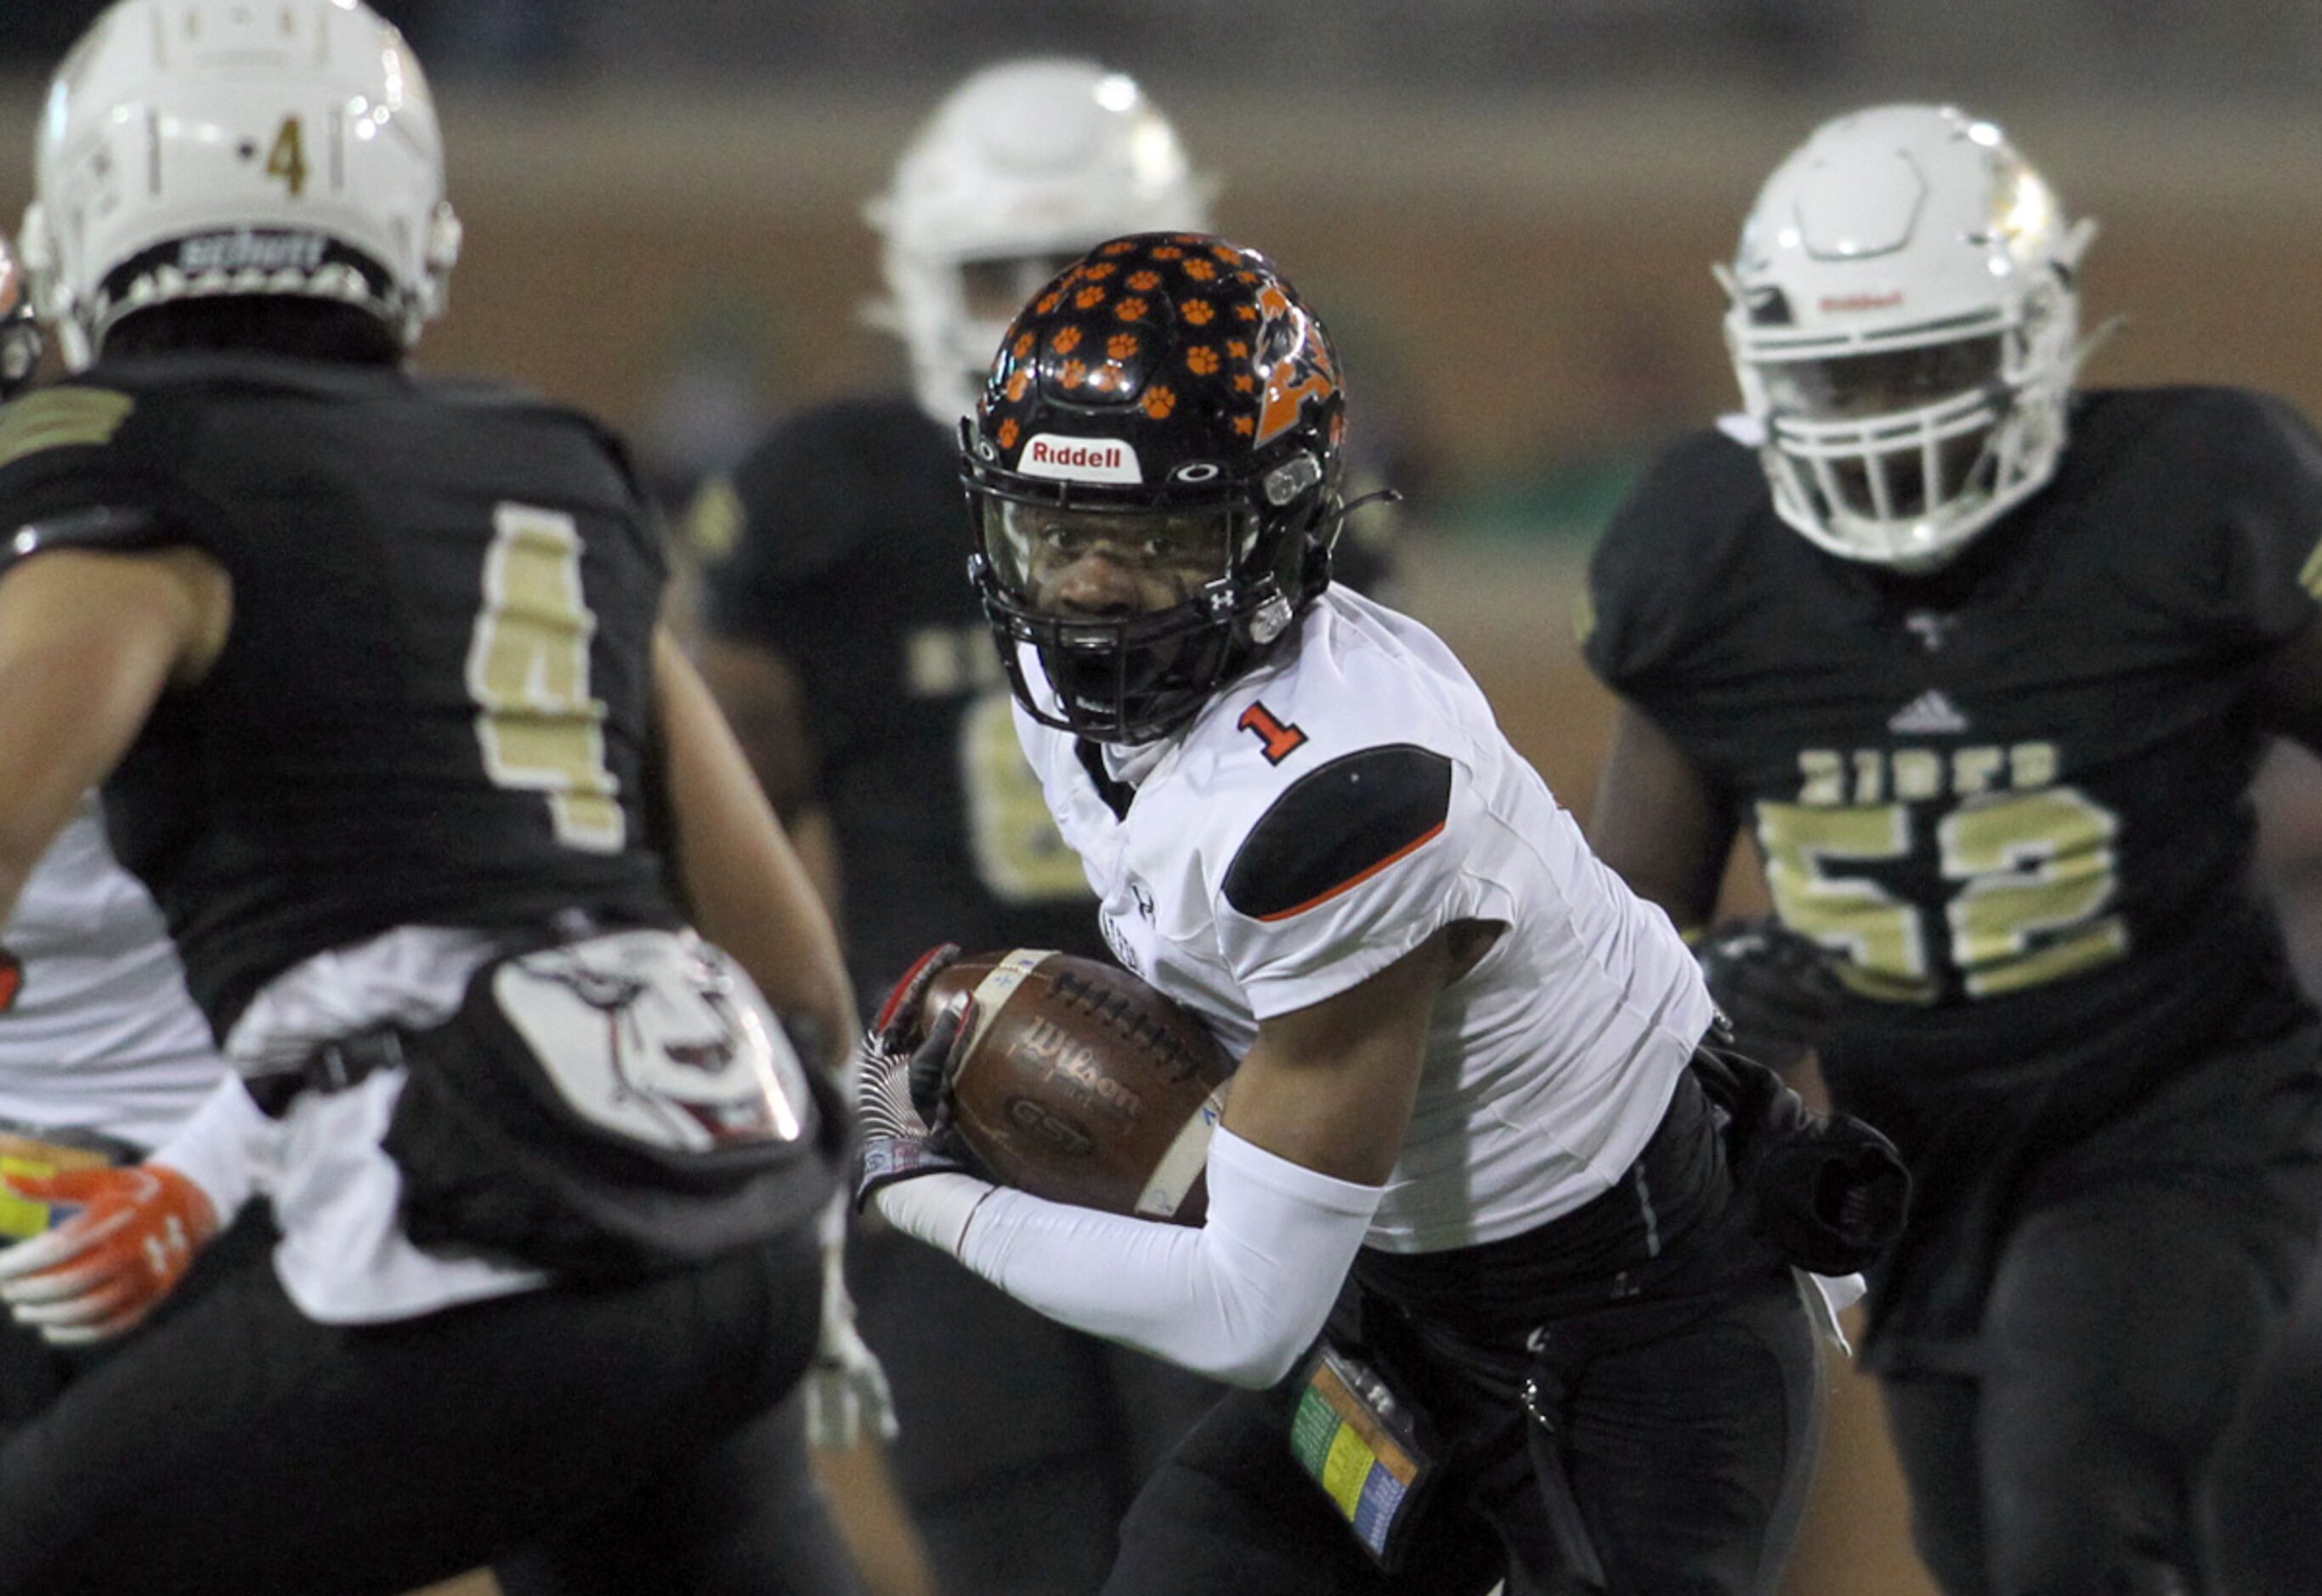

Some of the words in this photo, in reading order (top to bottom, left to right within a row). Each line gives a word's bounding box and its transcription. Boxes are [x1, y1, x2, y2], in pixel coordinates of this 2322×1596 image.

[265, 117, 309, 198] 4
[1033, 442, 1122, 467] Riddell
[466, 501, 626, 854] 4
[1237, 699, 1308, 767] 1
[1756, 787, 2130, 1005] 52
[1021, 1015, 1142, 1116] Wilson
